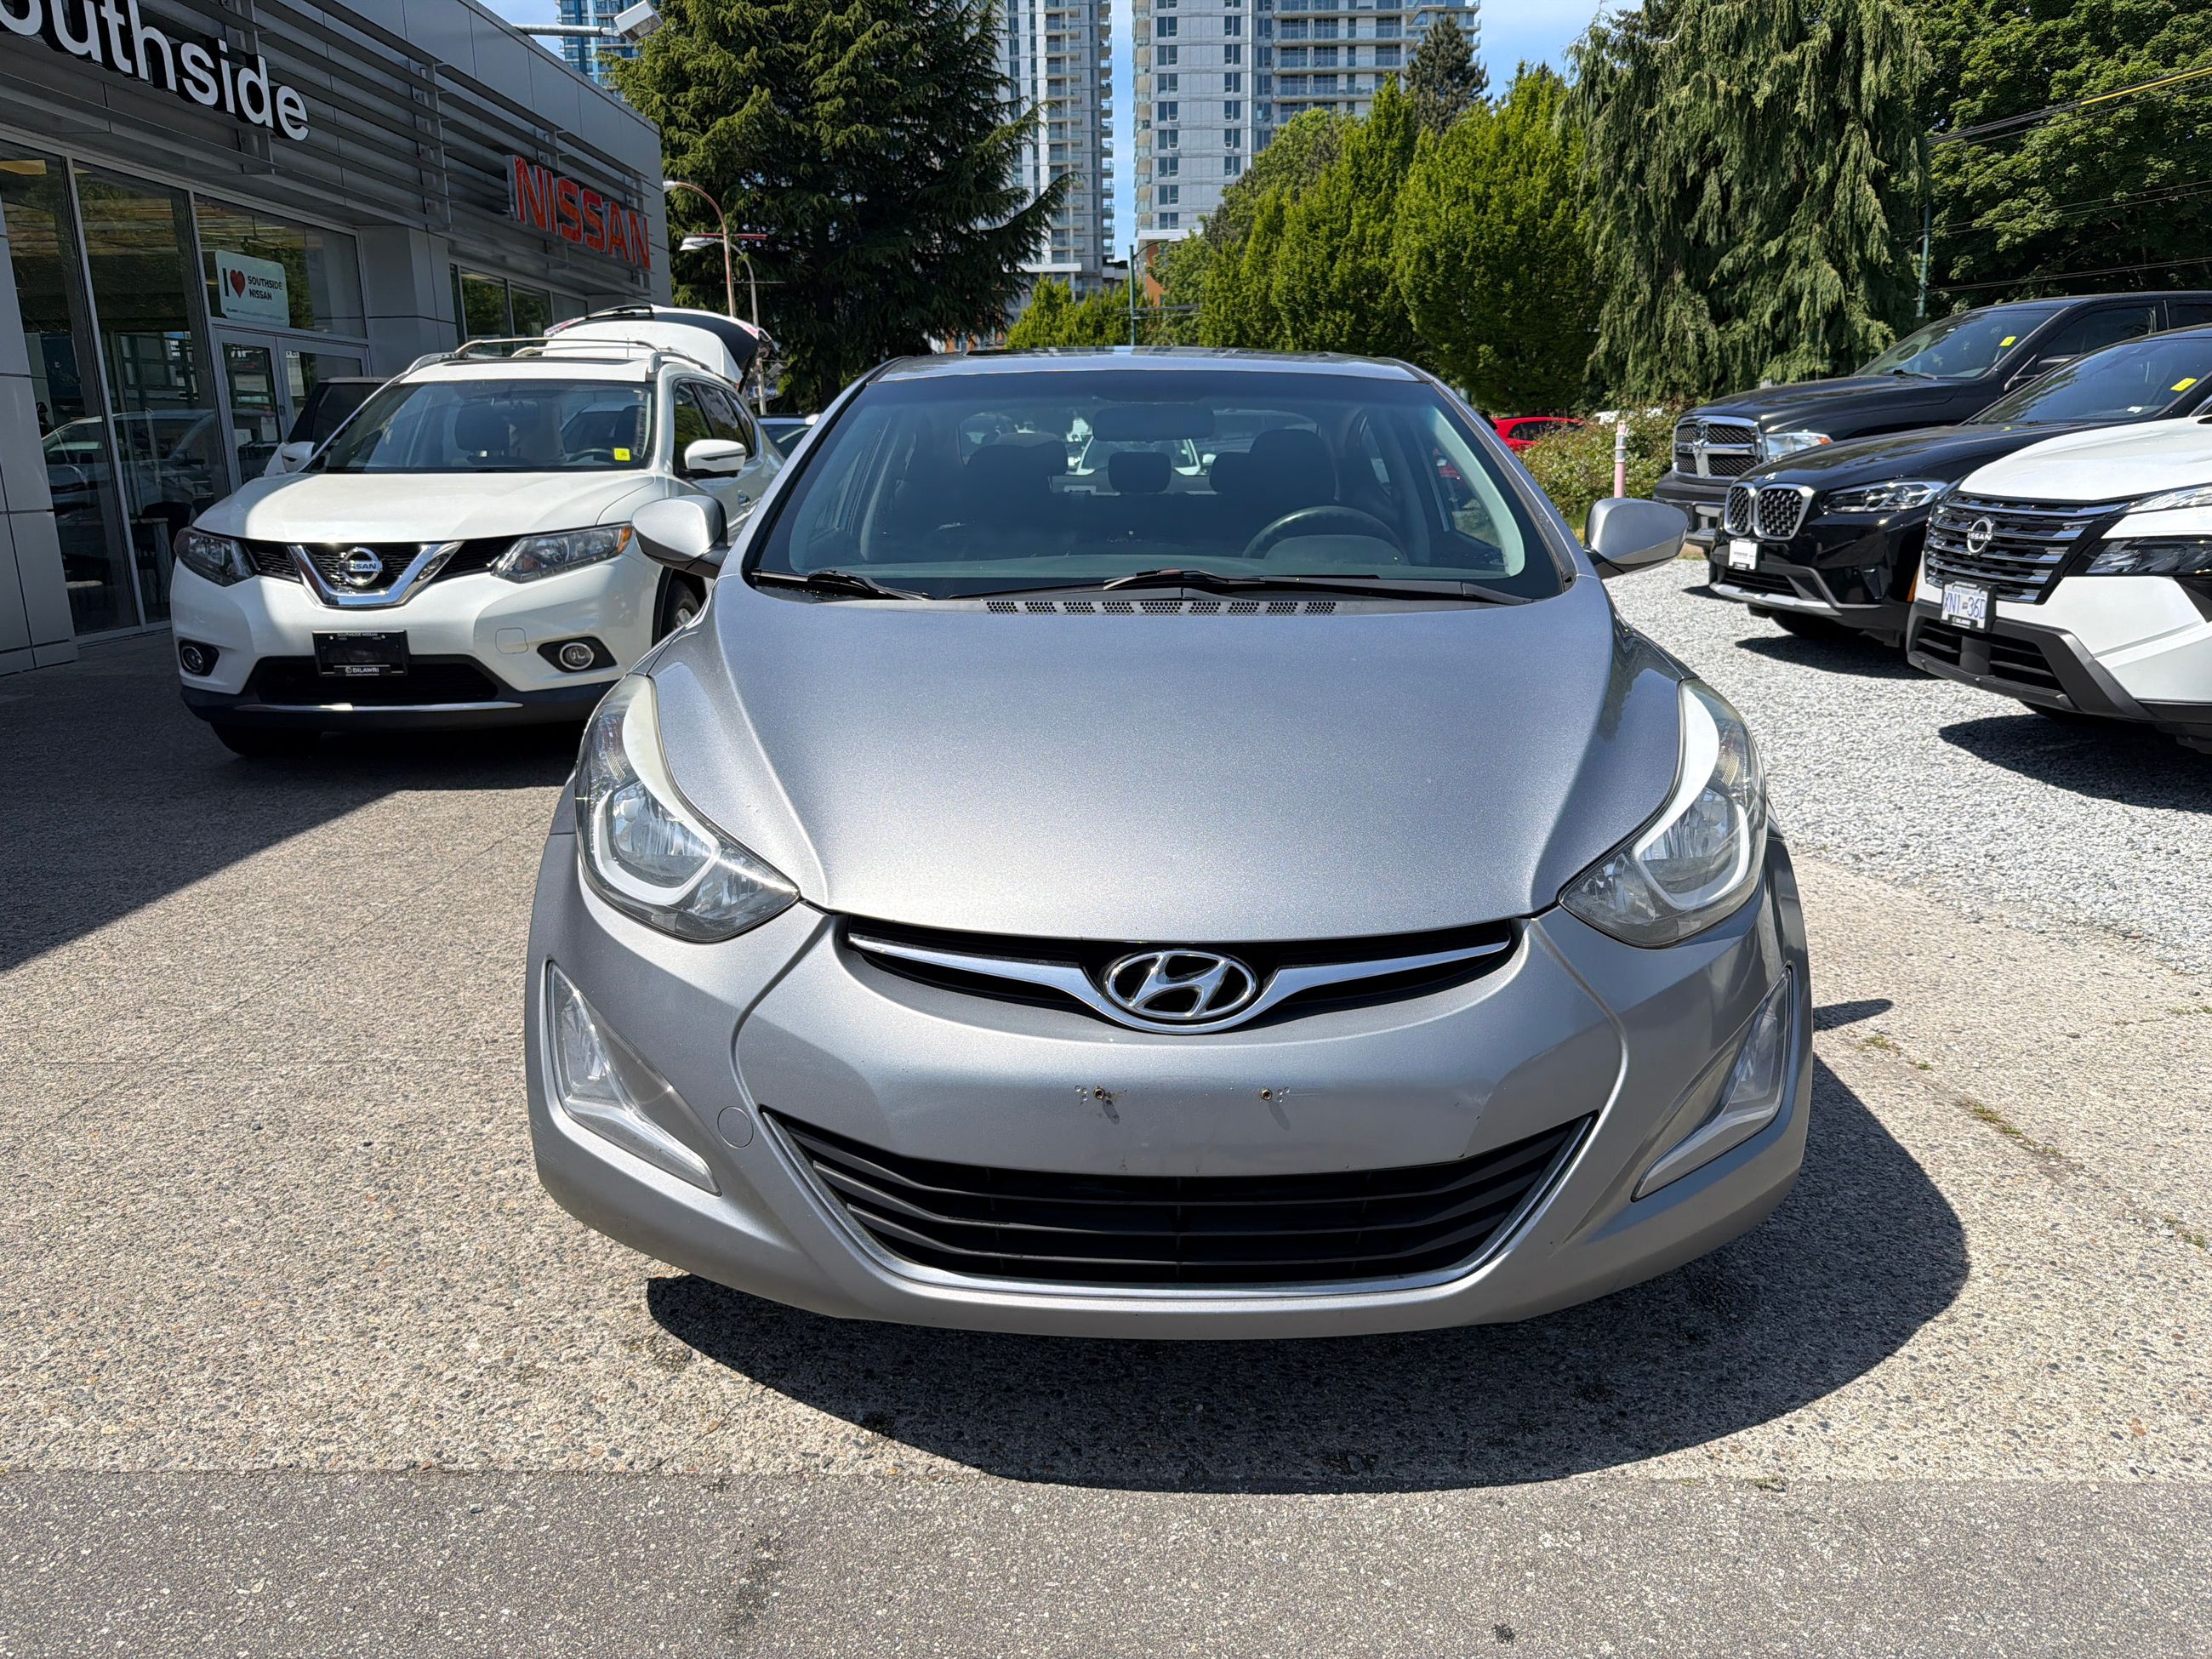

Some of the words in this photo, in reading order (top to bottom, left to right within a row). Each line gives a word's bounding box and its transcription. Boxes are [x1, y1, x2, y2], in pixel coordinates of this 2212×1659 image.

[512, 154, 652, 271] NISSAN
[222, 267, 230, 297] I
[247, 275, 282, 290] SOUTHSIDE
[248, 288, 273, 300] NISSAN
